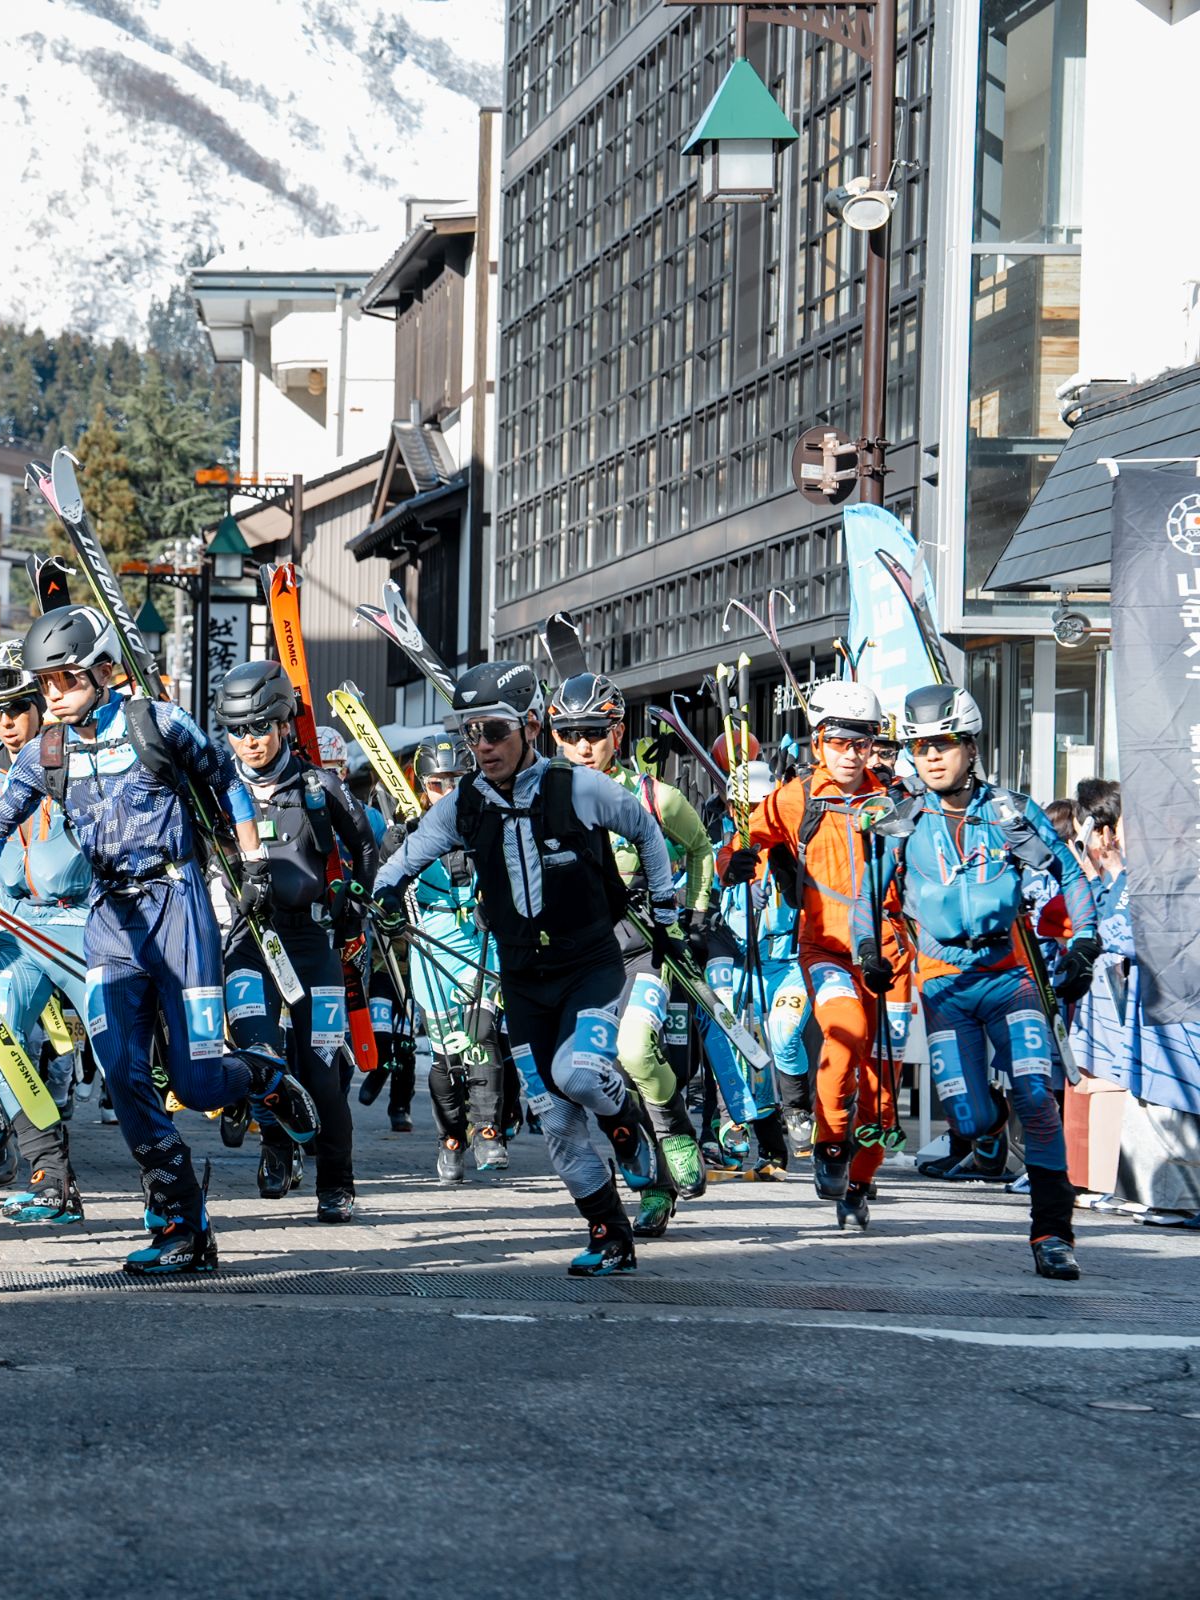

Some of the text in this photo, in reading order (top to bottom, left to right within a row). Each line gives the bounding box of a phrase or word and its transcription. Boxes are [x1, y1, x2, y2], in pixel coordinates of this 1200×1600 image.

[76, 529, 146, 654] DYNAFIT
[283, 619, 298, 666] ATOMIC
[497, 664, 531, 689] DYNAFIT
[356, 723, 414, 811] FISCHER
[267, 936, 281, 959] 64
[709, 968, 732, 984] 10
[235, 982, 250, 999] 7
[644, 988, 660, 1006] 6
[325, 1003, 339, 1024] 7
[372, 1006, 389, 1019] 16
[775, 996, 802, 1009] 63
[202, 1007, 214, 1031] 1
[666, 1014, 687, 1030] 33
[890, 1020, 905, 1039] 8
[590, 1025, 608, 1048] 3
[1024, 1027, 1043, 1049] 5
[10, 1050, 40, 1097] TRANSALP
[932, 1050, 945, 1075] 5
